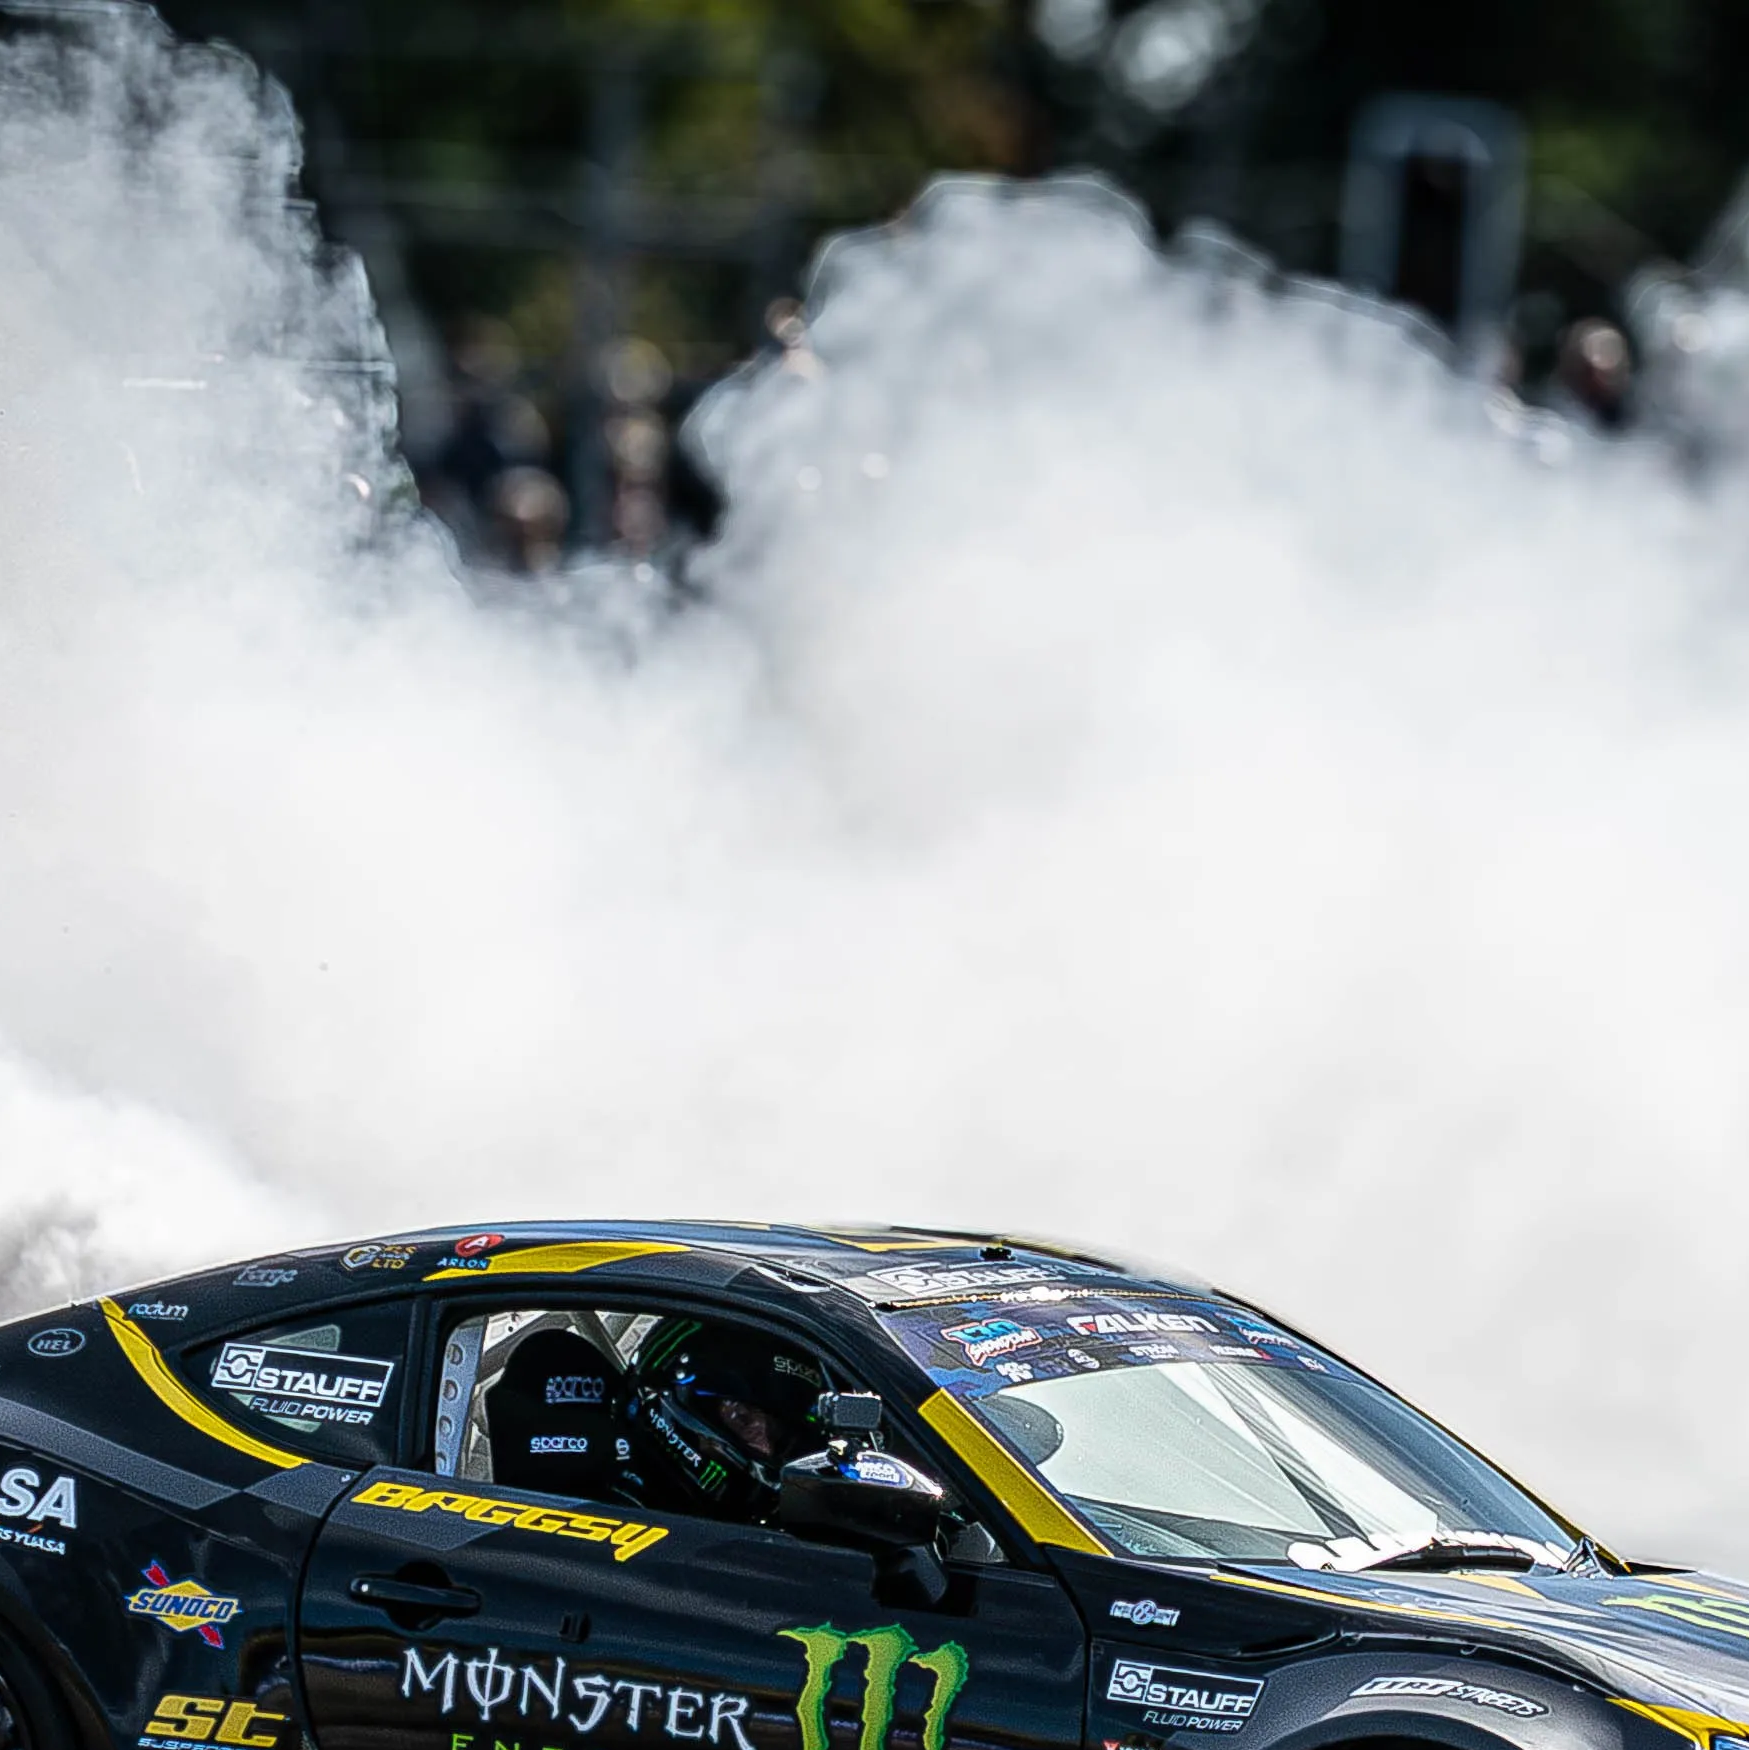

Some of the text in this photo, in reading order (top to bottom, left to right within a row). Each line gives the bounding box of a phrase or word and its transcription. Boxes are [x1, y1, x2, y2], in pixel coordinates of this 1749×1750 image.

[435, 1256, 490, 1270] ARLON
[1066, 1313, 1221, 1336] FALKEN
[255, 1367, 384, 1400] STAUFF
[250, 1397, 374, 1426] FLUID POWER
[529, 1436, 588, 1452] sparco
[351, 1481, 669, 1562] BAGGSY
[12, 1530, 67, 1556] YUASA
[132, 1591, 234, 1621] SUNOCO
[1146, 1683, 1256, 1713] STAUFF
[1447, 1684, 1545, 1716] STREETS
[1142, 1710, 1244, 1732] FLUID POWER
